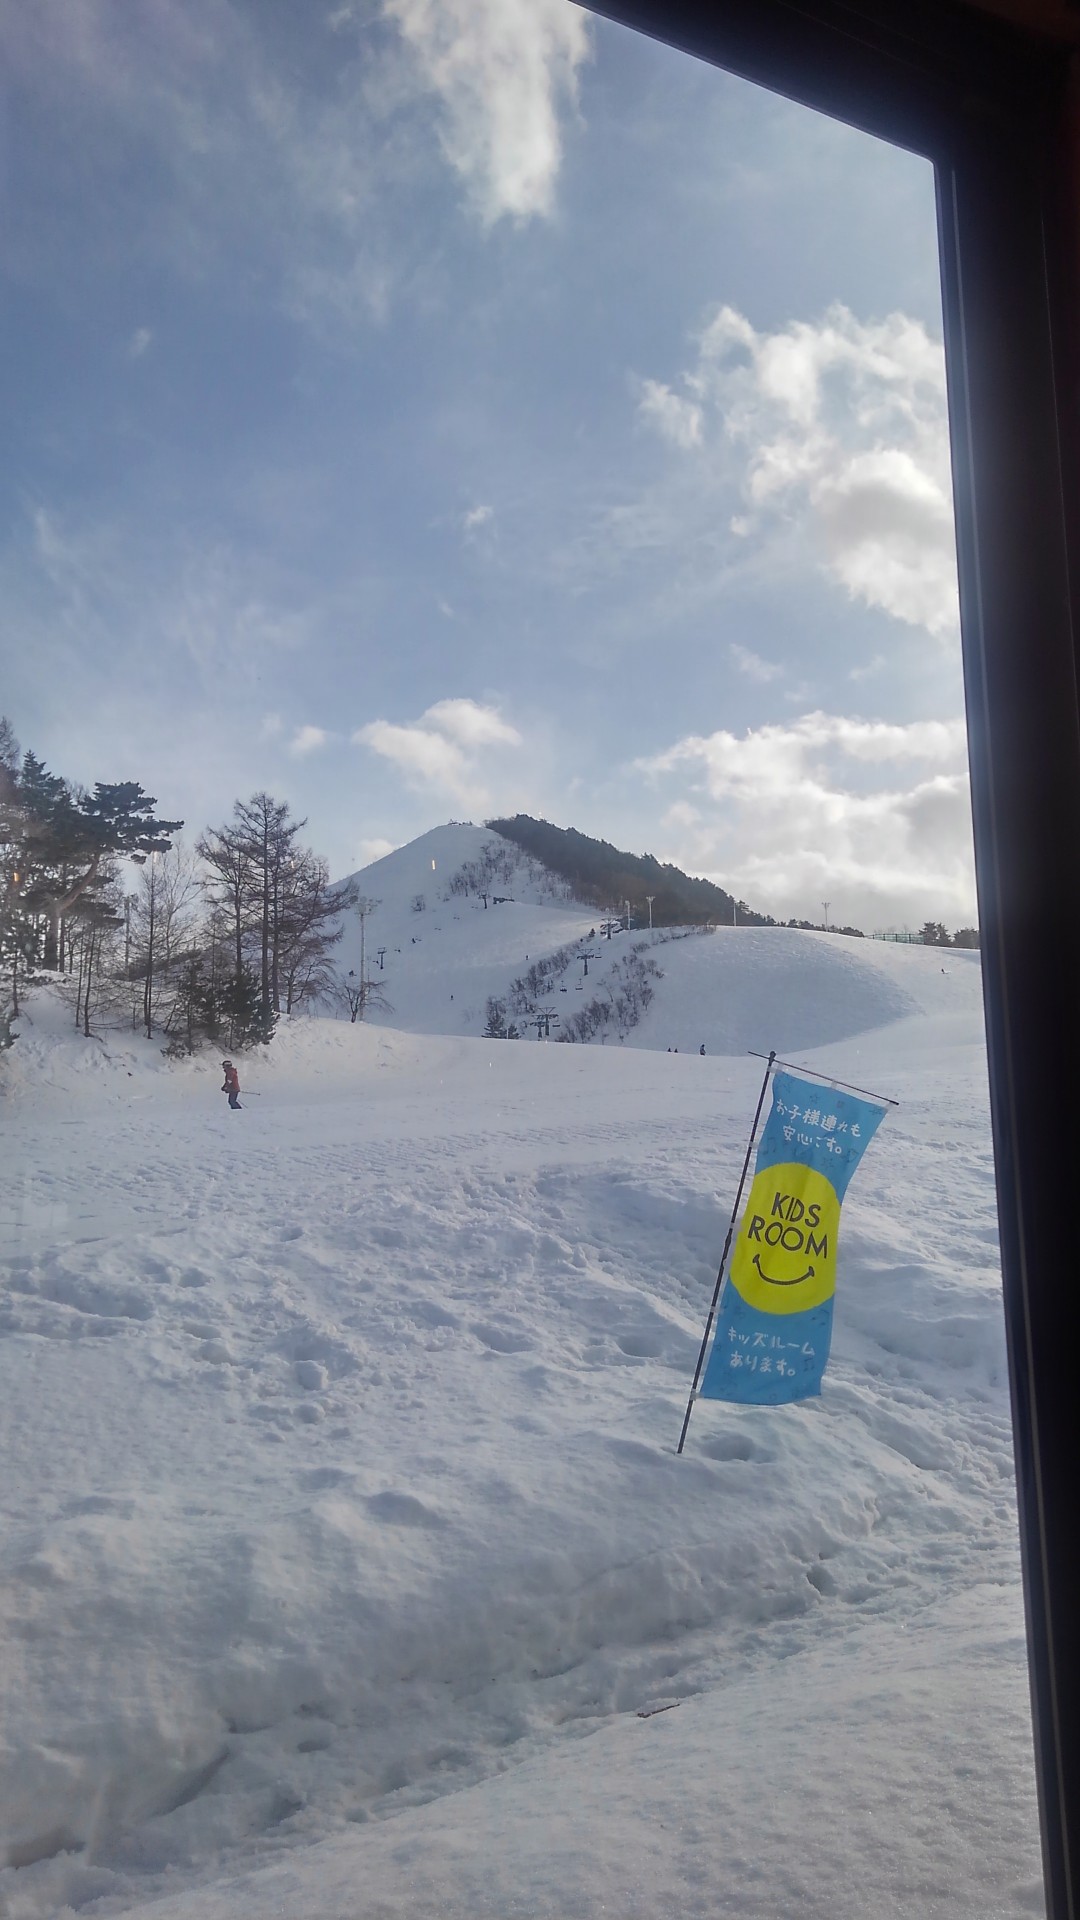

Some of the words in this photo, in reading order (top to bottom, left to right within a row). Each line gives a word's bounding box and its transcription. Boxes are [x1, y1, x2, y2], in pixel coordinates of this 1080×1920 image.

[775, 1098, 861, 1138] お子様連れも
[770, 1192, 821, 1228] KIDS
[747, 1214, 828, 1259] ROOM
[728, 1326, 816, 1356] キッズルーム
[730, 1350, 796, 1377] あります。
